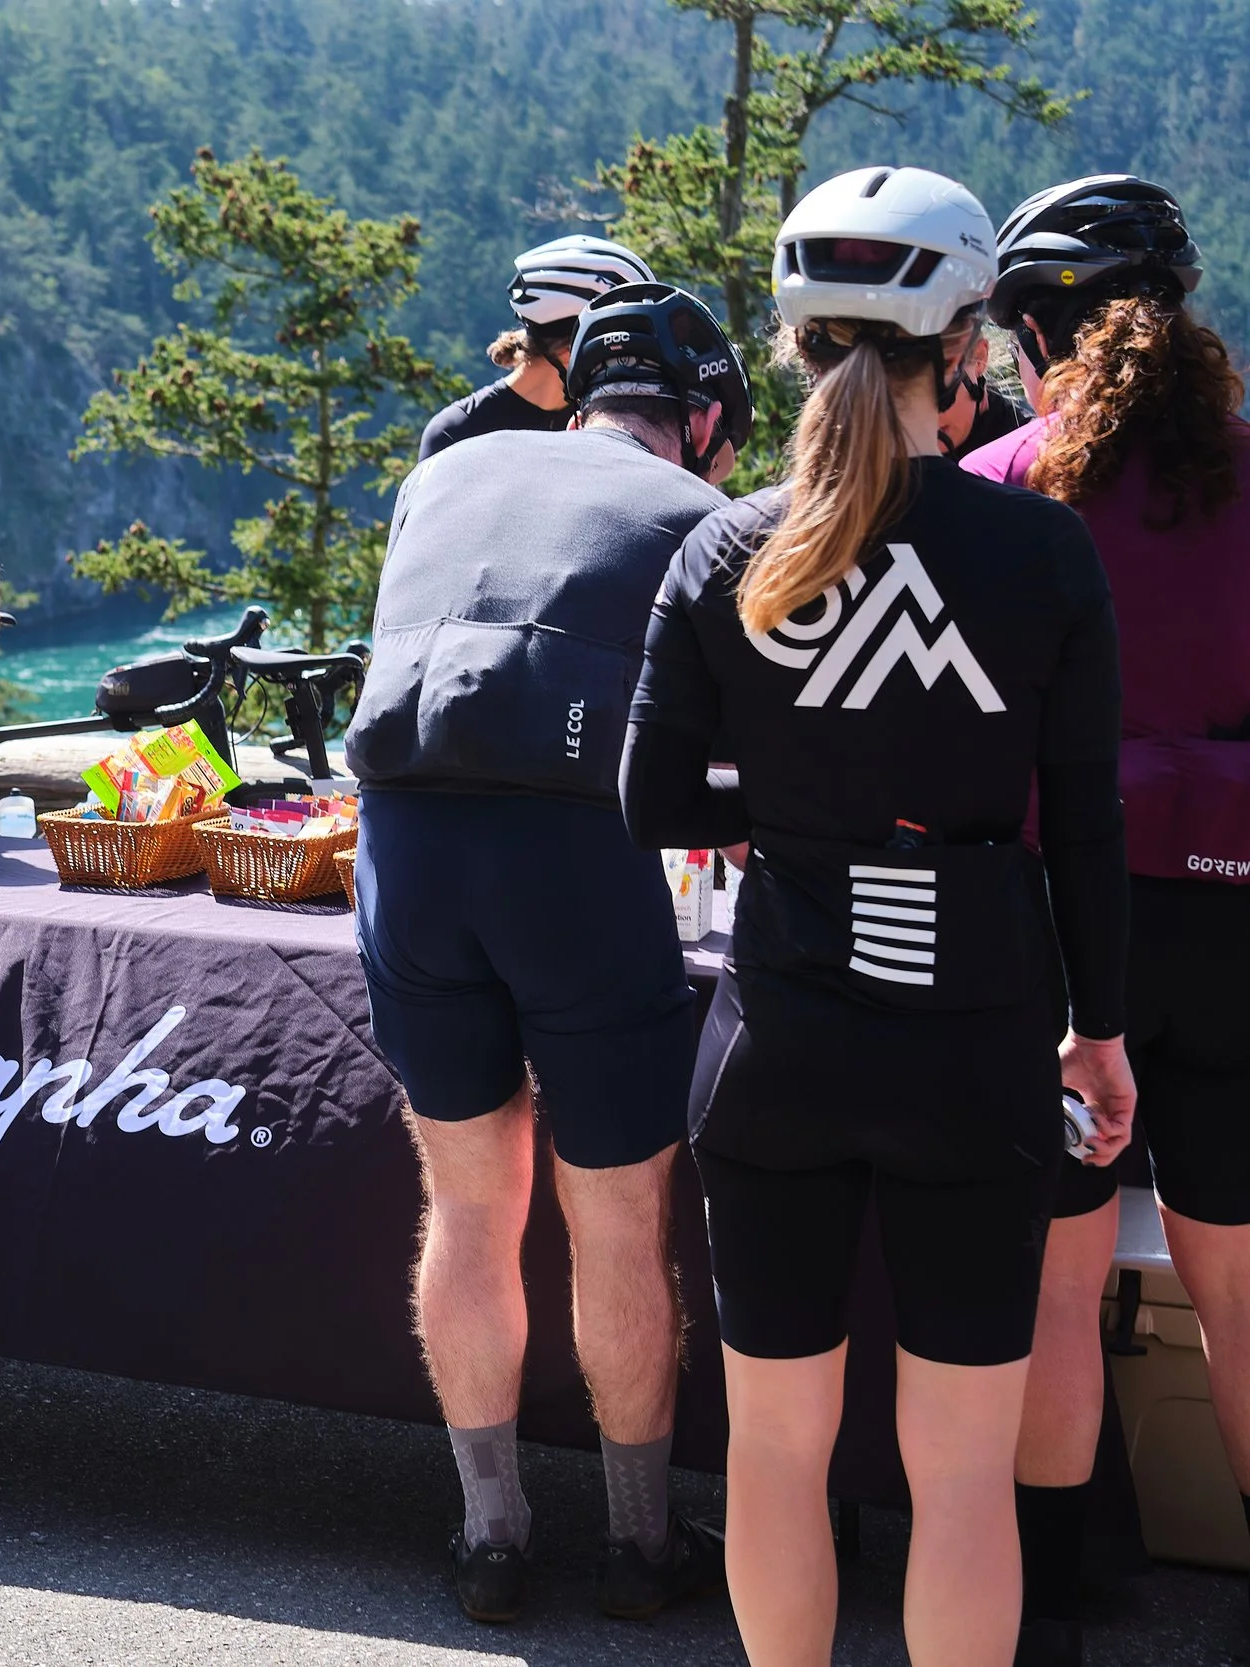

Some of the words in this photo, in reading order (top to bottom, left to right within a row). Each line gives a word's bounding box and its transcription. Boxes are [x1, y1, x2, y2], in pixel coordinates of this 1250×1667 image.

[566, 698, 585, 734] COL
[565, 734, 581, 760] LE
[1187, 854, 1250, 877] GOREW
